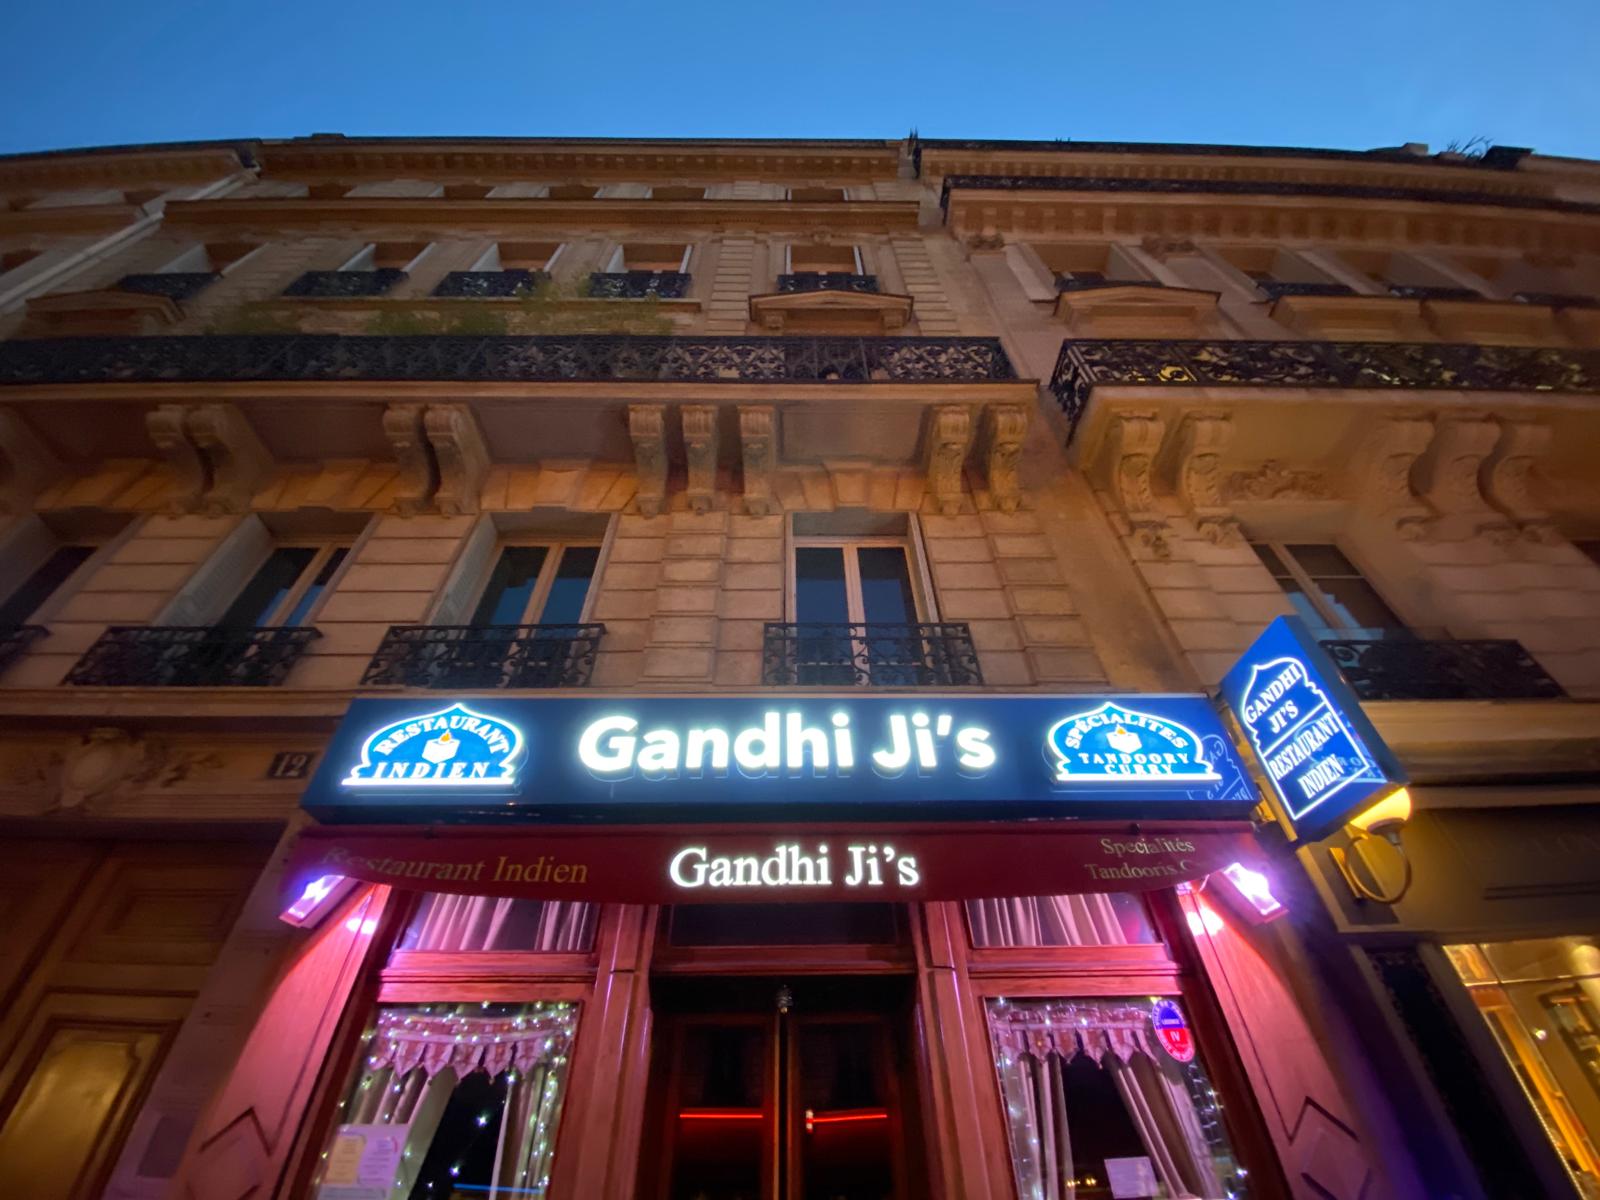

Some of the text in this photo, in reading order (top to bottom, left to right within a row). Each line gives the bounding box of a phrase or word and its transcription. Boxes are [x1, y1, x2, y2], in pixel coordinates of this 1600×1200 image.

[1245, 663, 1302, 723] GANDHI
[373, 715, 510, 756] RESTAURANT
[1268, 700, 1299, 734] JI'S
[578, 712, 996, 772] Gandhi Ji's
[1078, 753, 1189, 764] TANDOORY
[1268, 712, 1340, 781] RESTAURANT
[274, 754, 307, 777] 12
[371, 762, 490, 778] INDIEN
[1104, 764, 1174, 775] CURRY
[1298, 753, 1345, 799] INDIEN
[320, 849, 588, 883] Restaurant Indien
[669, 845, 920, 888] Gandhi Ji's
